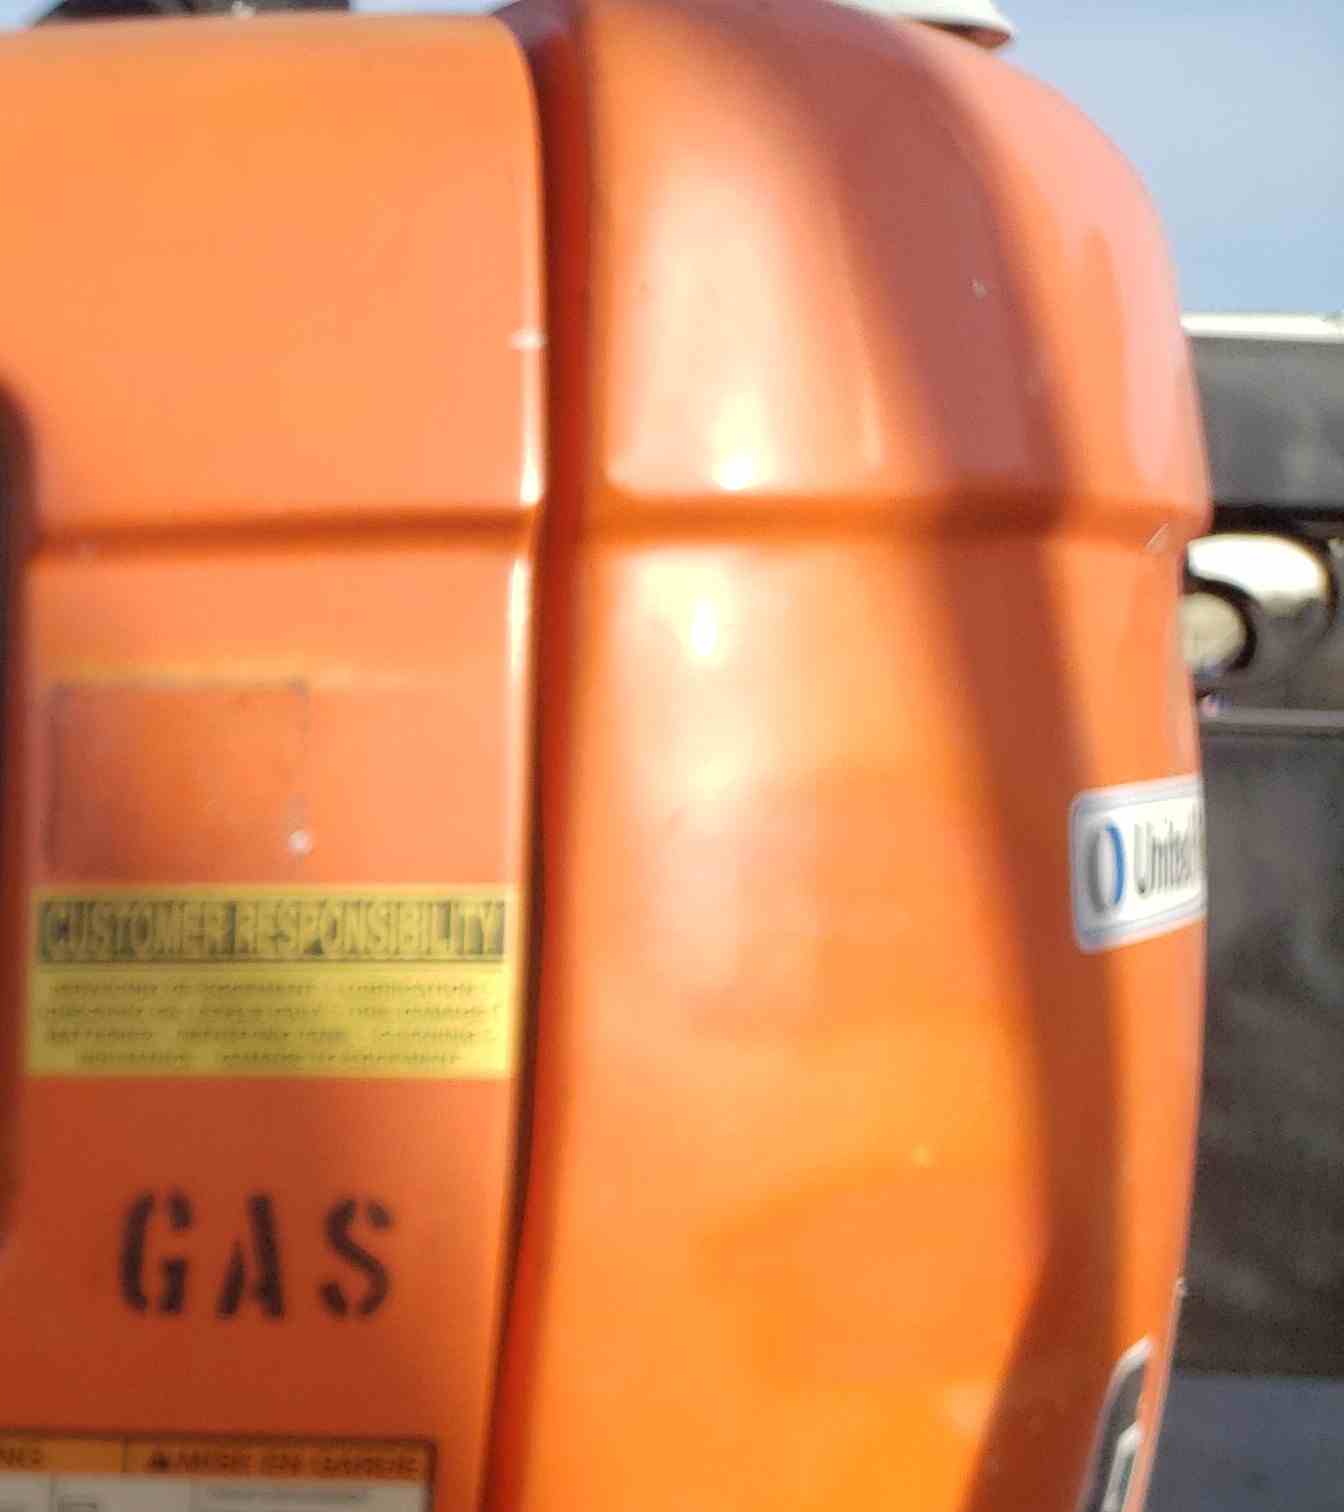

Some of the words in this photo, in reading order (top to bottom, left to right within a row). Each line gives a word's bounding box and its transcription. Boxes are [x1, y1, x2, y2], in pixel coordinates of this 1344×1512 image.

[39, 897, 227, 961] CUSTOMER
[234, 897, 505, 962] RESPONSIBILITY
[118, 1188, 394, 1319] GAS
